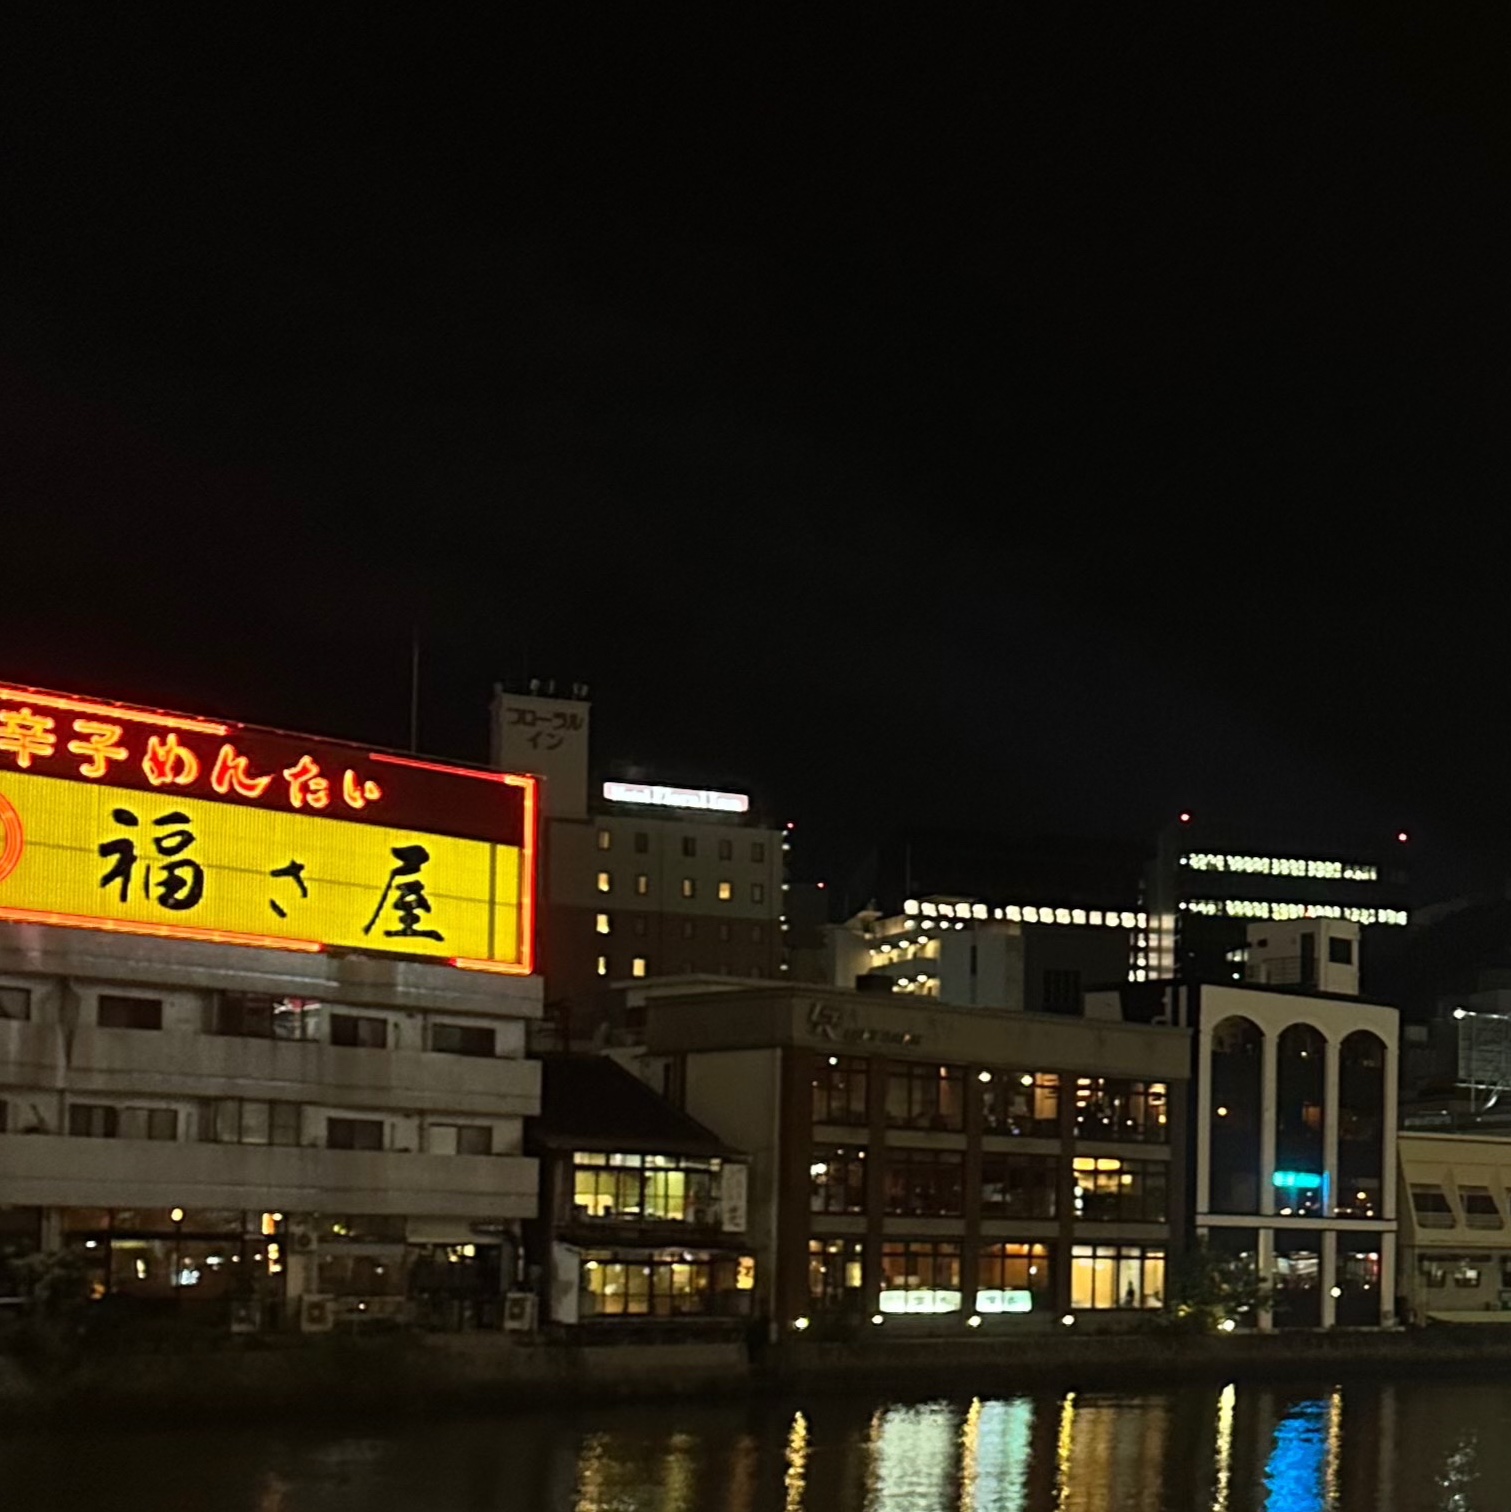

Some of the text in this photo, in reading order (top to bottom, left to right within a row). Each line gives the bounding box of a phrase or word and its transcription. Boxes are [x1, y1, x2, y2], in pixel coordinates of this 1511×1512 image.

[0, 706, 383, 809] 辛子めんたい
[527, 731, 564, 750] イン
[98, 808, 444, 942] 福さ屋
